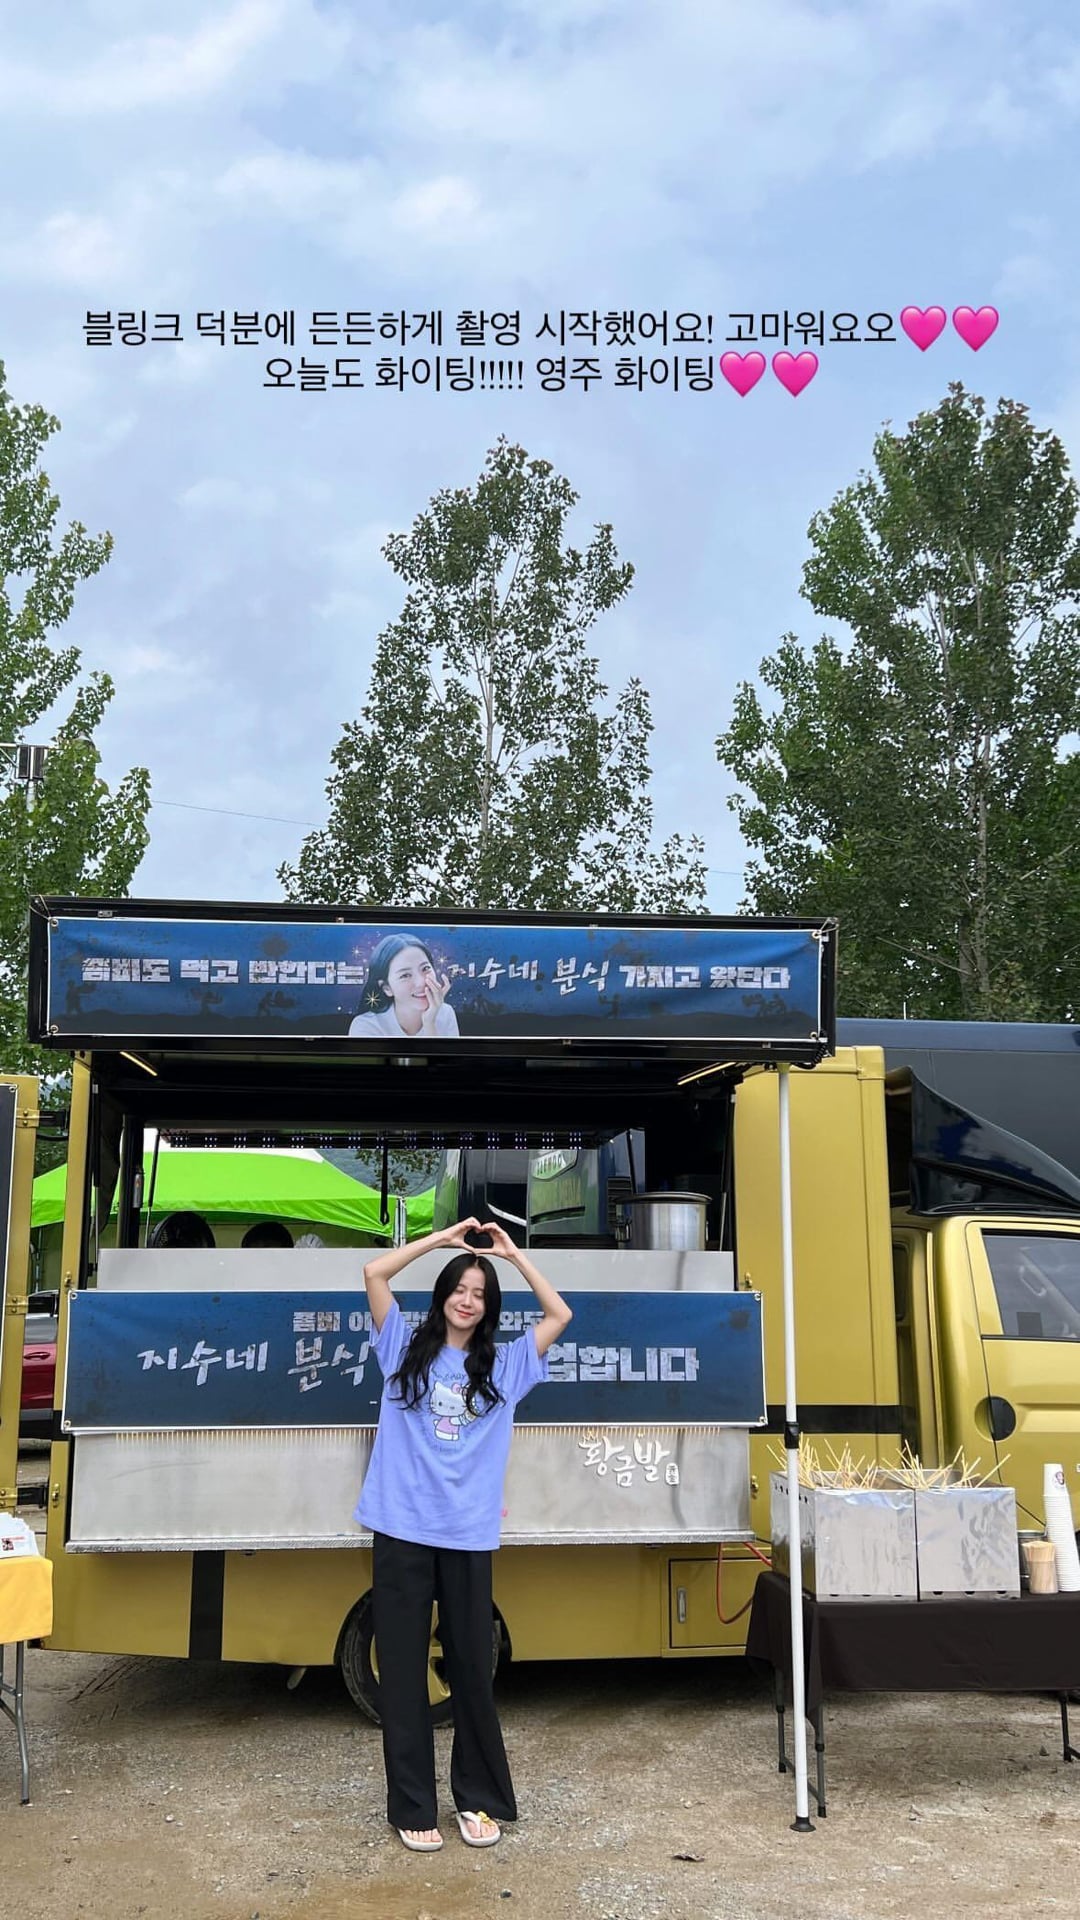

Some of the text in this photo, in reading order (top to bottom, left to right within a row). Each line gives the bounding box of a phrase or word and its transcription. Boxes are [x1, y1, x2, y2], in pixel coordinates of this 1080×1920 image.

[82, 957, 171, 983] 좀비도
[180, 959, 239, 983] 먹고
[447, 957, 538, 990] 지수네
[552, 956, 609, 996] 분식
[619, 965, 701, 988] 가지고
[710, 966, 791, 989] 왔단다
[293, 1311, 341, 1332] 좀비
[136, 1340, 269, 1386] 지수네
[546, 1342, 699, 1382] 업합니다
[578, 1430, 671, 1487] 황금발
